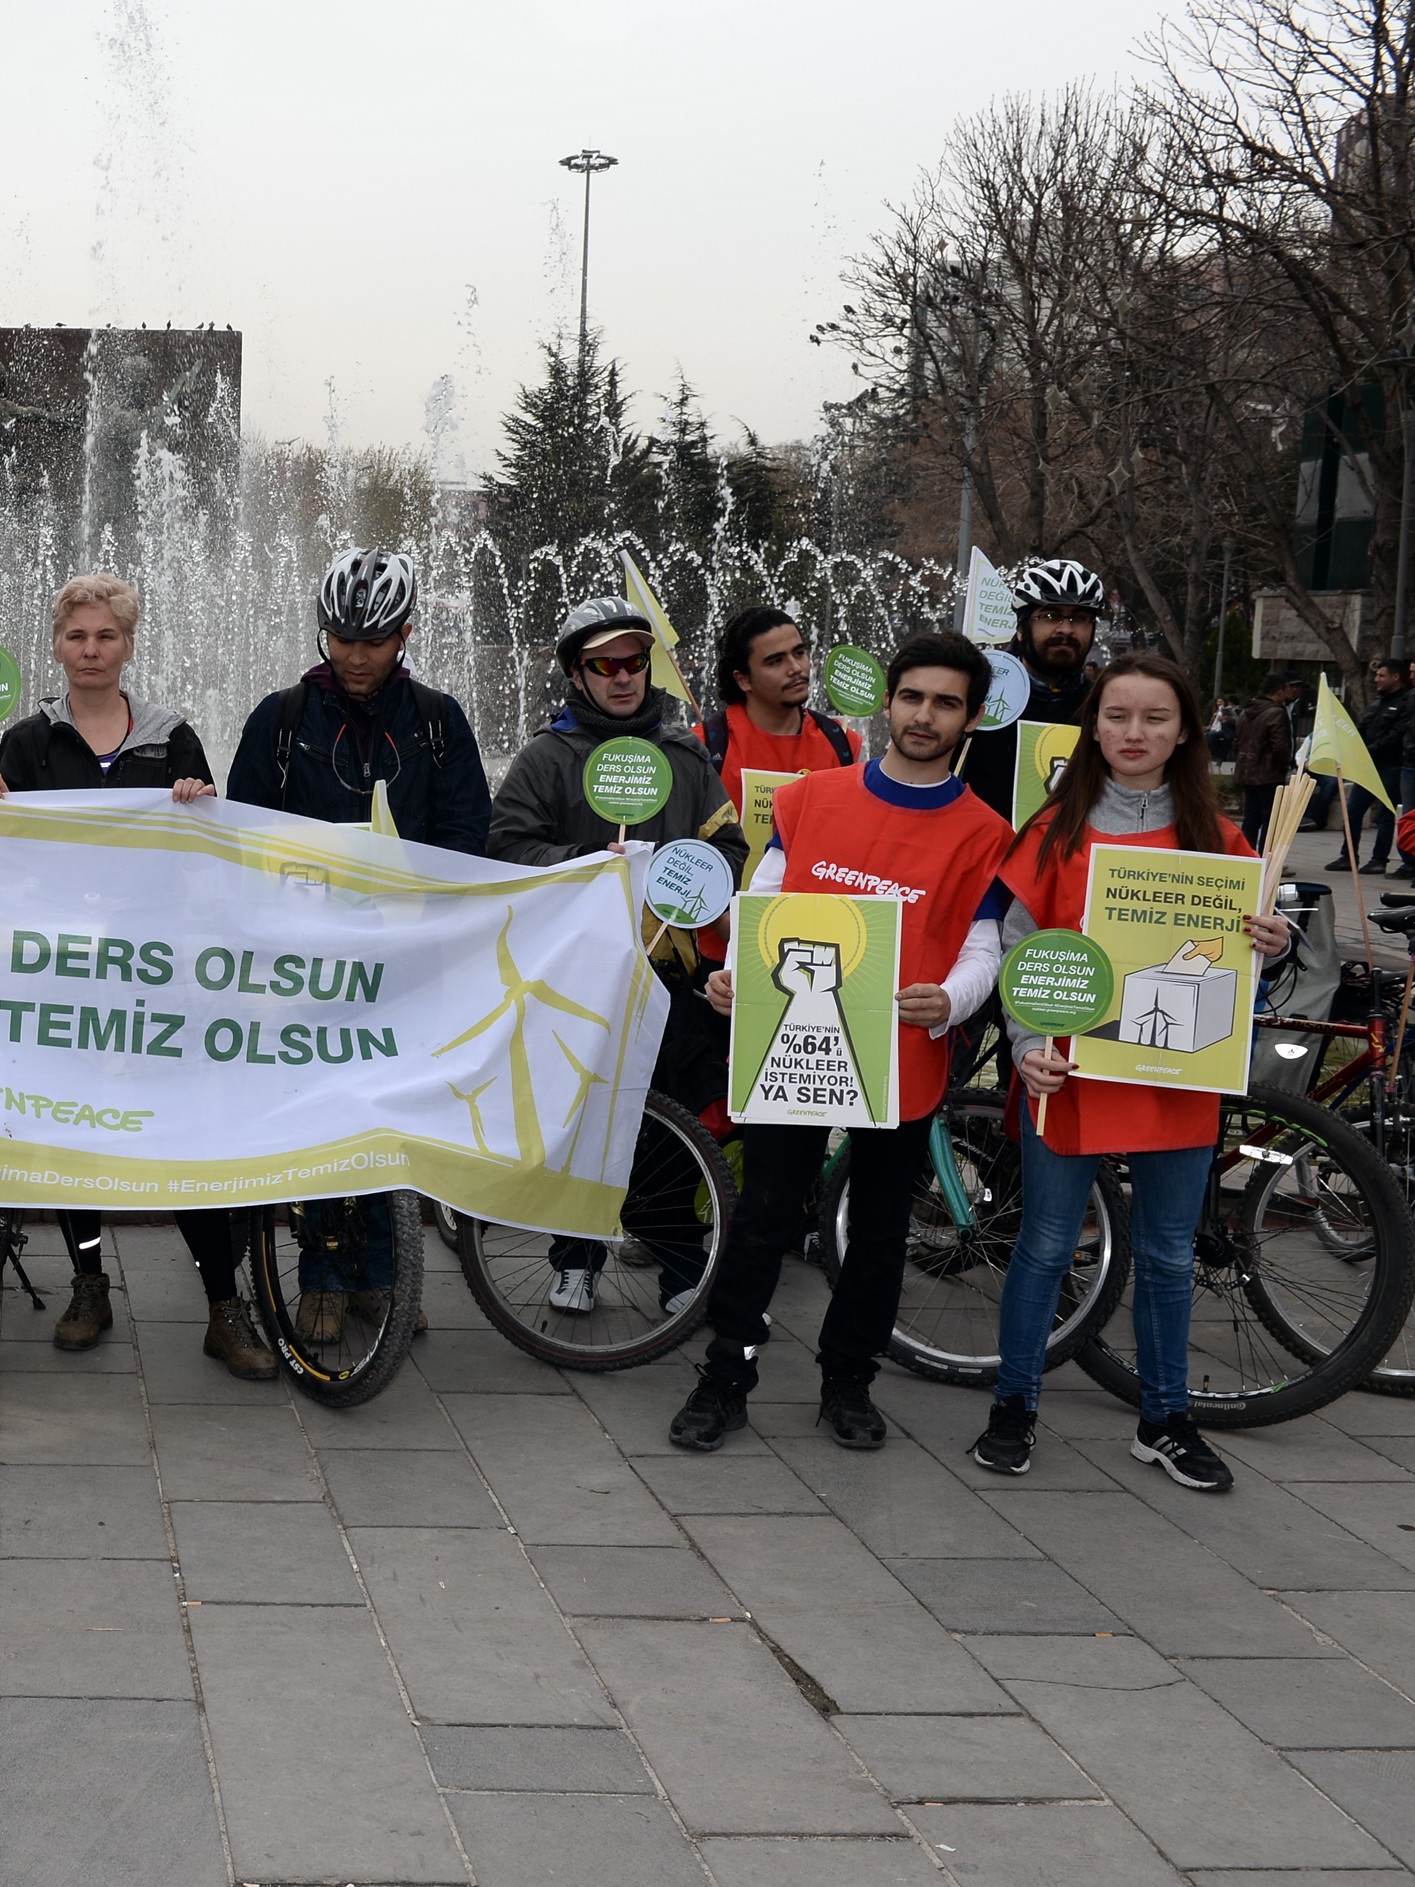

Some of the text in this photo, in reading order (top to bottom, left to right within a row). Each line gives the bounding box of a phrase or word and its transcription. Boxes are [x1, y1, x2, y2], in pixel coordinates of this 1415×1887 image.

[979, 602, 1015, 616] TEMİZ
[979, 614, 1017, 630] ENERJ
[834, 660, 877, 684] DERS OLSUN
[838, 653, 873, 674] FUKUŞİMA
[830, 675, 850, 690] TEMİZ
[850, 686, 876, 701] OLSUN
[602, 753, 651, 764] FUKUŞİMA
[596, 764, 657, 774] DERS OLSUN
[599, 774, 653, 785] ENERJİMİZ
[593, 784, 658, 795] TEMİZ OLSUN
[667, 856, 694, 877] DEĞİL,
[672, 847, 714, 873] NÜKLEER
[663, 866, 692, 886] TEMİZ
[811, 860, 926, 904] GREENPEACE
[1109, 867, 1246, 891] TÜRKİYE'NİN SEÇİMİ
[656, 876, 692, 897] ENERJİ
[1106, 886, 1242, 914] NÜKLEER DEĞİL,
[1105, 906, 1241, 933] TEMİZ ENERJİ
[1025, 948, 1088, 963] FUKUŞİMA
[10, 929, 174, 986] DERS
[194, 946, 385, 1003] OLSUN
[1017, 961, 1095, 976] DERS OLSUN
[1020, 975, 1089, 989] ENERJİMİZ
[1012, 987, 1096, 1003] TEMİZ OLSUN
[0, 999, 186, 1059] TEMİZ
[203, 1017, 399, 1066] OLSUN
[784, 1023, 840, 1034] TÜRKİYE'NİN
[770, 1055, 848, 1072] NÜKLEER
[1135, 1064, 1182, 1075] GREENPEACE
[765, 1068, 854, 1087] İSTEMİYOR!
[760, 1084, 858, 1106] YA SEN?
[167, 1152, 411, 1195] #EnerjimizTemizOlsun
[289, 1359, 304, 1375] CST
